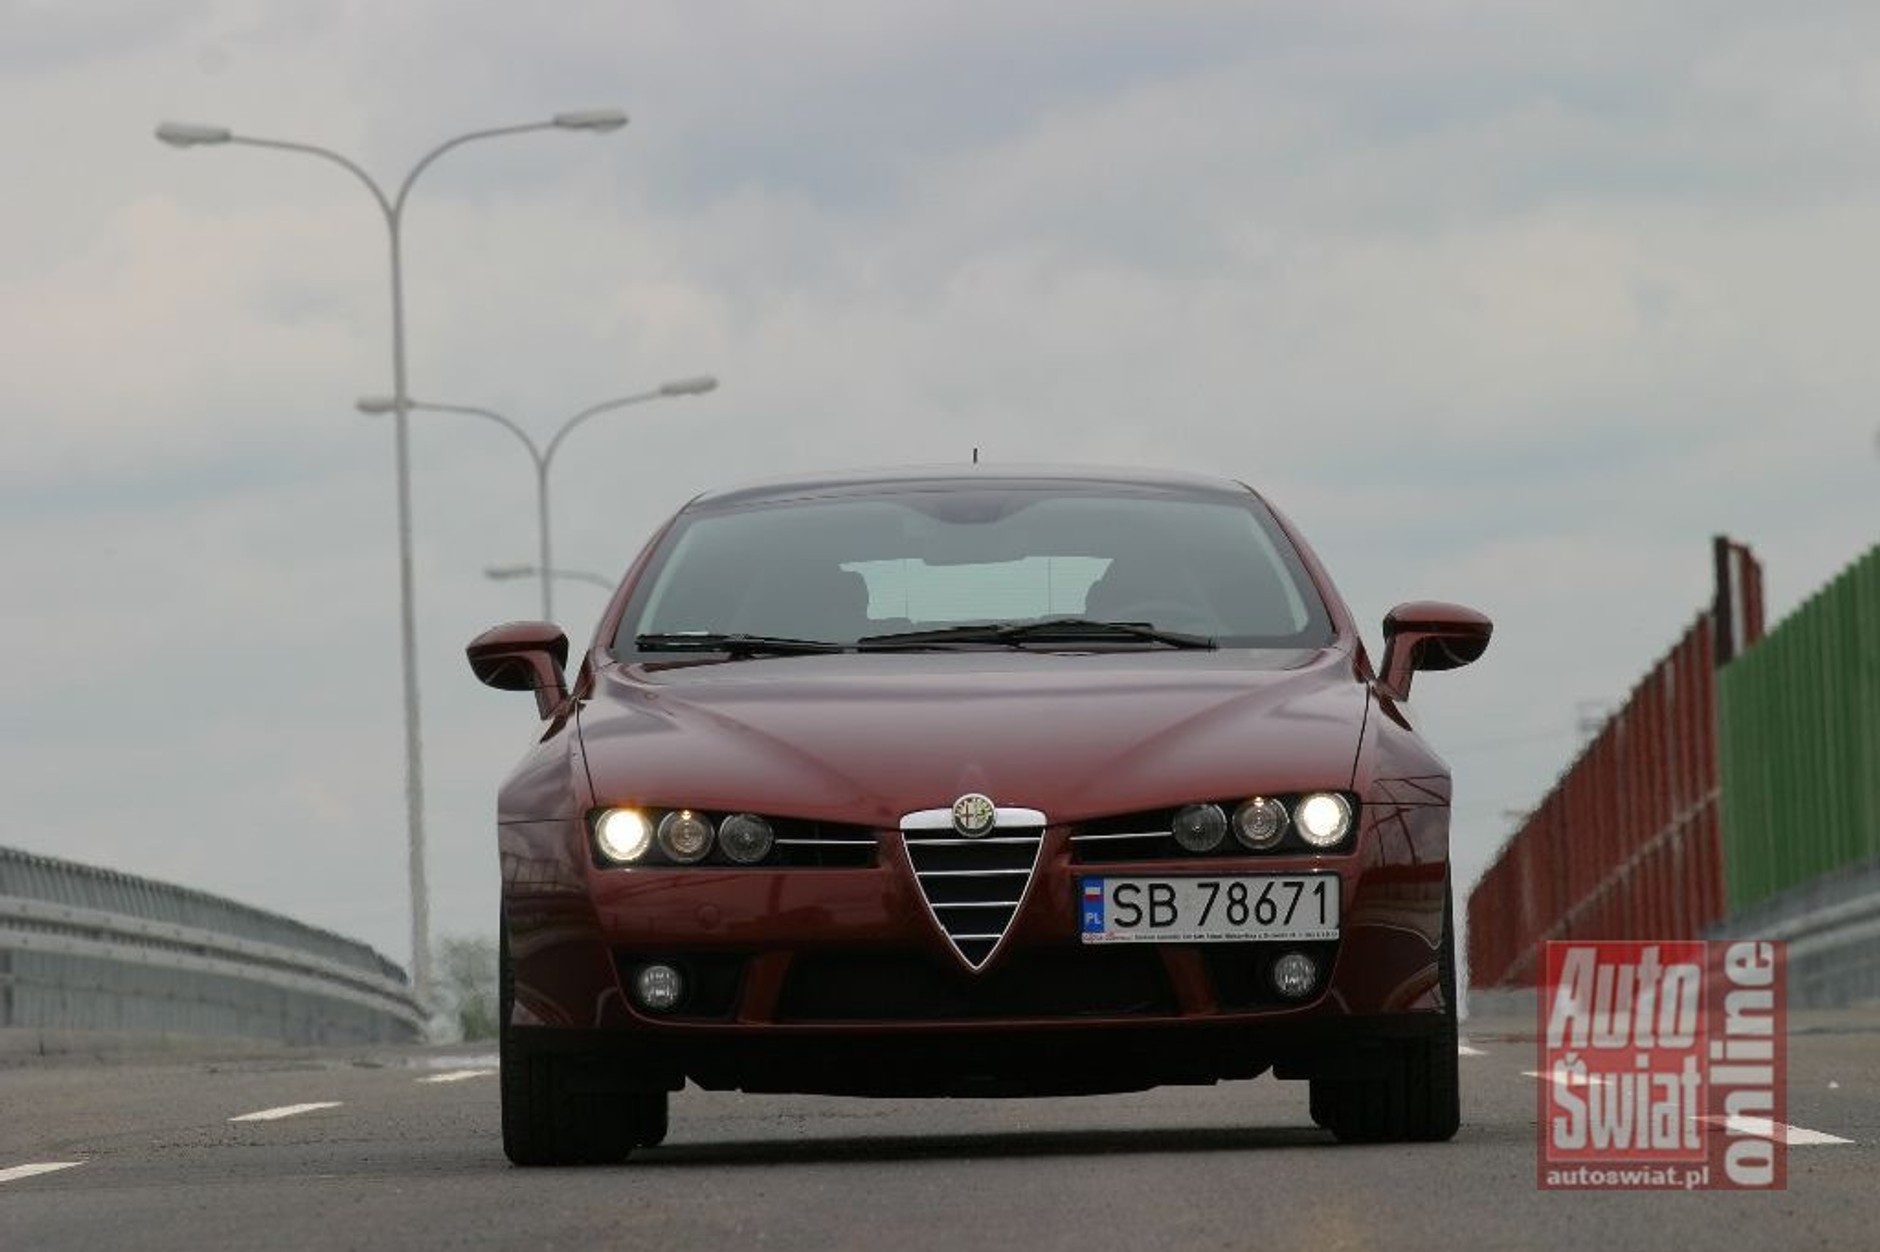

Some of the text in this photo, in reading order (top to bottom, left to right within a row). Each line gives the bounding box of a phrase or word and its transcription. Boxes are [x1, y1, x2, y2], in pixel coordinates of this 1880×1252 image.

[1087, 912, 1102, 925] PL
[1112, 881, 1326, 928] SB 78671
